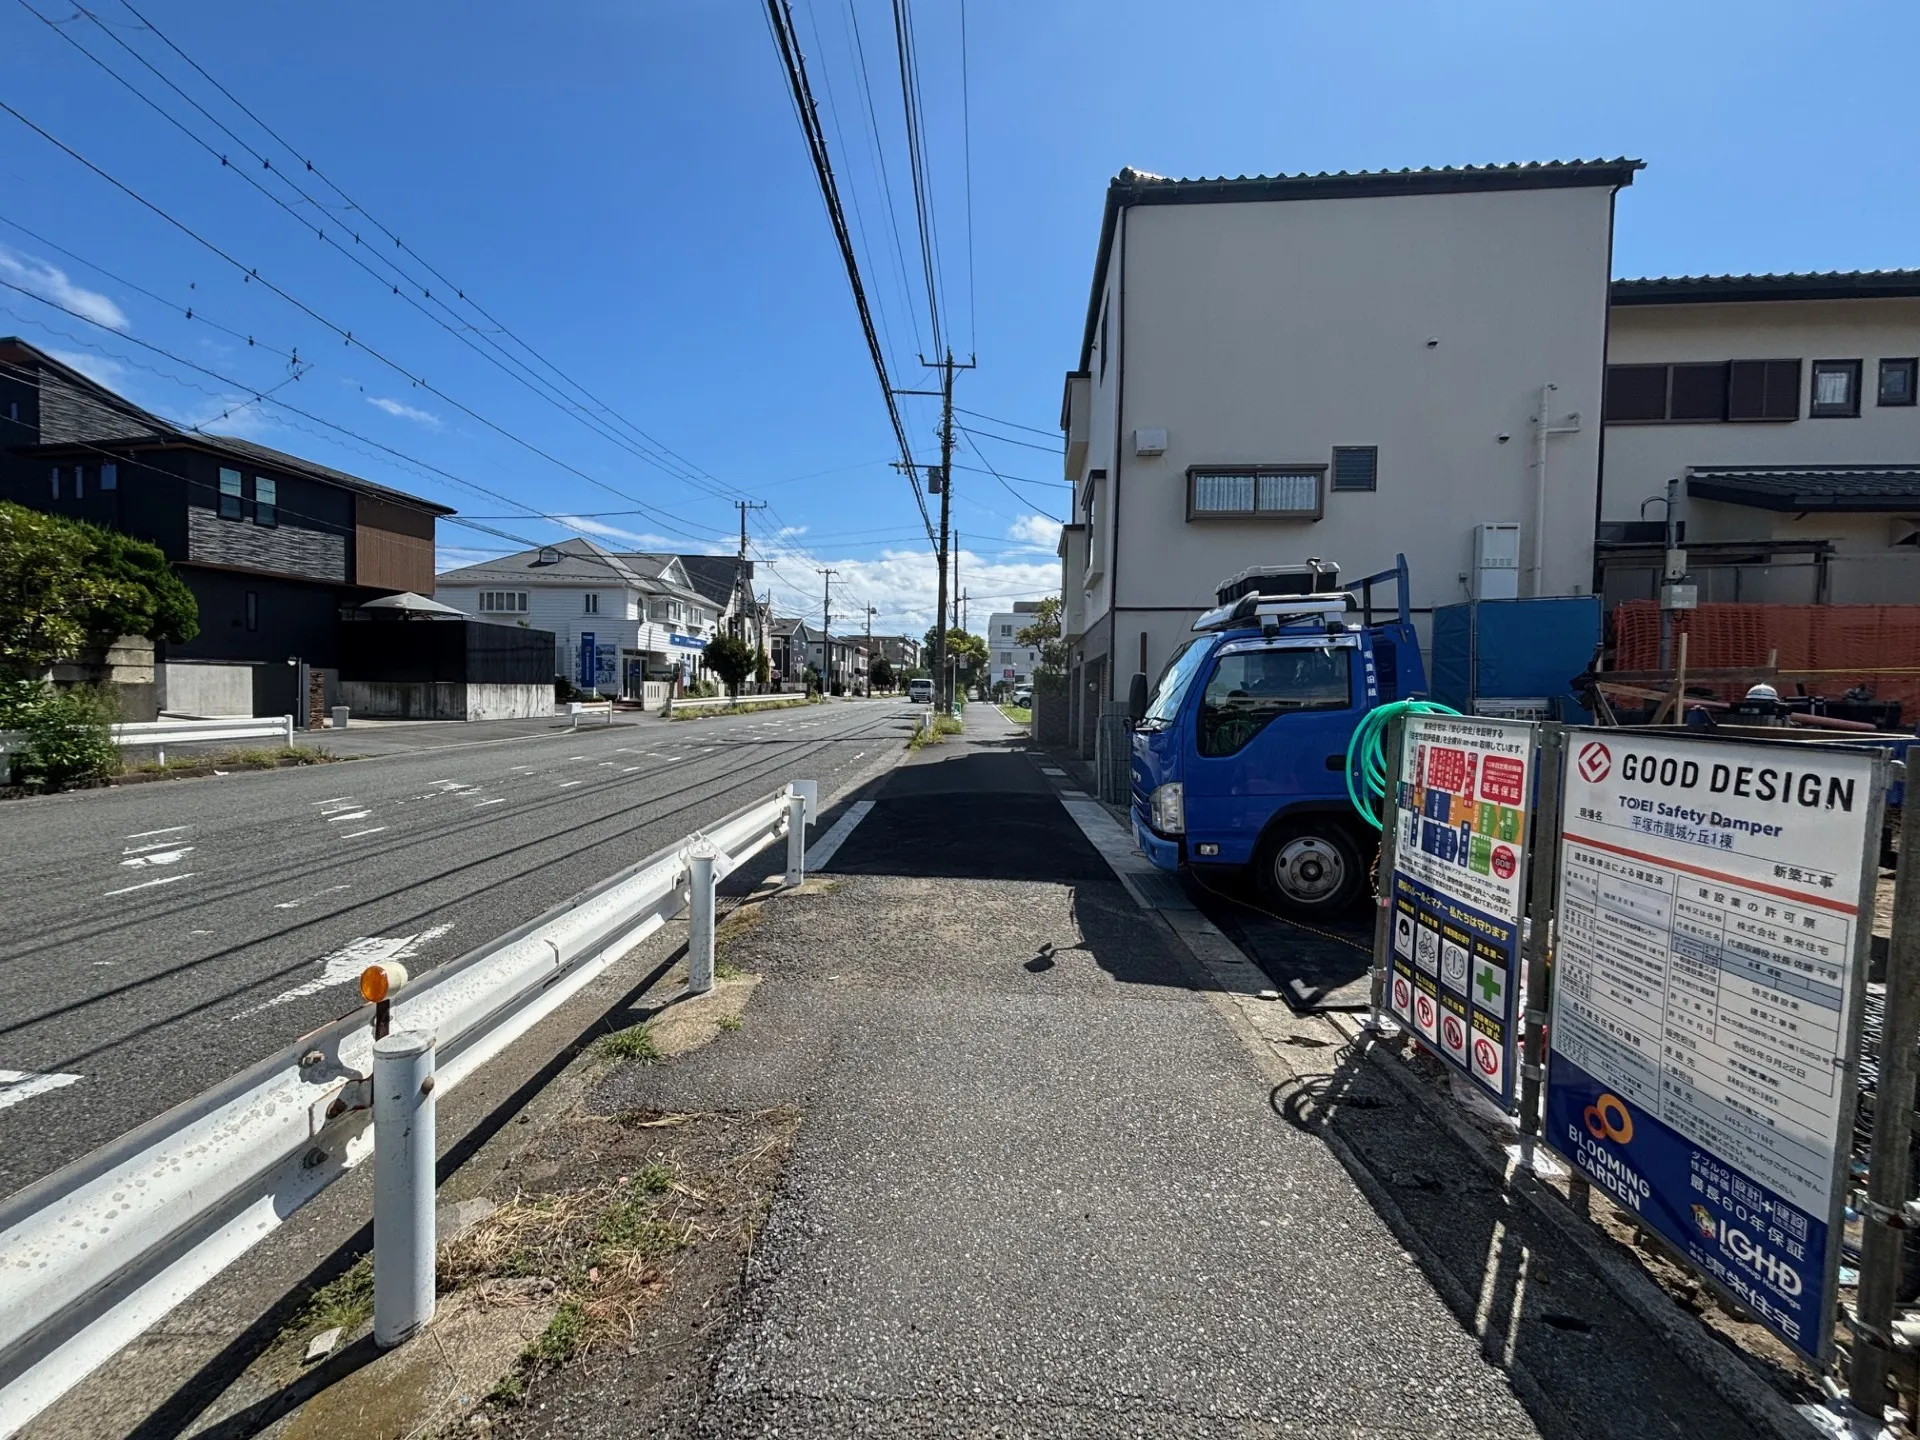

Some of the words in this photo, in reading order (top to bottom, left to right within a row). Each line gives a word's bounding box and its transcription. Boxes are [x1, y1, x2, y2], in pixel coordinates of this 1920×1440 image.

[1483, 782, 1519, 799] 延長保証
[1622, 753, 1699, 789] GOOD
[1710, 764, 1855, 812] DESIGN
[1579, 807, 1603, 821] 現場名
[1656, 802, 1705, 826] Safety
[1710, 811, 1783, 838] Damper
[1575, 852, 1663, 885] 建築基準法による確認済
[1774, 865, 1833, 889] 新築工事
[1449, 905, 1509, 941] 私たちは守ります
[1699, 887, 1816, 930] 建設業の許可票
[1476, 943, 1505, 960] 安全第一
[1737, 921, 1777, 941] 株式会社
[1783, 935, 1829, 957] 東栄住宅
[1773, 953, 1792, 966] 社長
[1473, 1019, 1500, 1041] 立入禁止
[1664, 1046, 1695, 1068] 連絡先
[1733, 1040, 1806, 1079] 令和6年9月22日
[1568, 1124, 1650, 1198] BLOOMING
[1690, 1160, 1730, 1191] 性能評価
[1577, 1150, 1640, 1211] GARDEN
[1691, 1151, 1730, 1180] ダブルの
[1734, 1176, 1761, 1200] 設計
[1776, 1203, 1805, 1231] 建設
[1690, 1174, 1805, 1262] 最長60年保証
[1720, 1219, 1802, 1297] IGHD
[1735, 1255, 1762, 1282] Group
[1705, 1255, 1799, 1341] 東栄住宅
